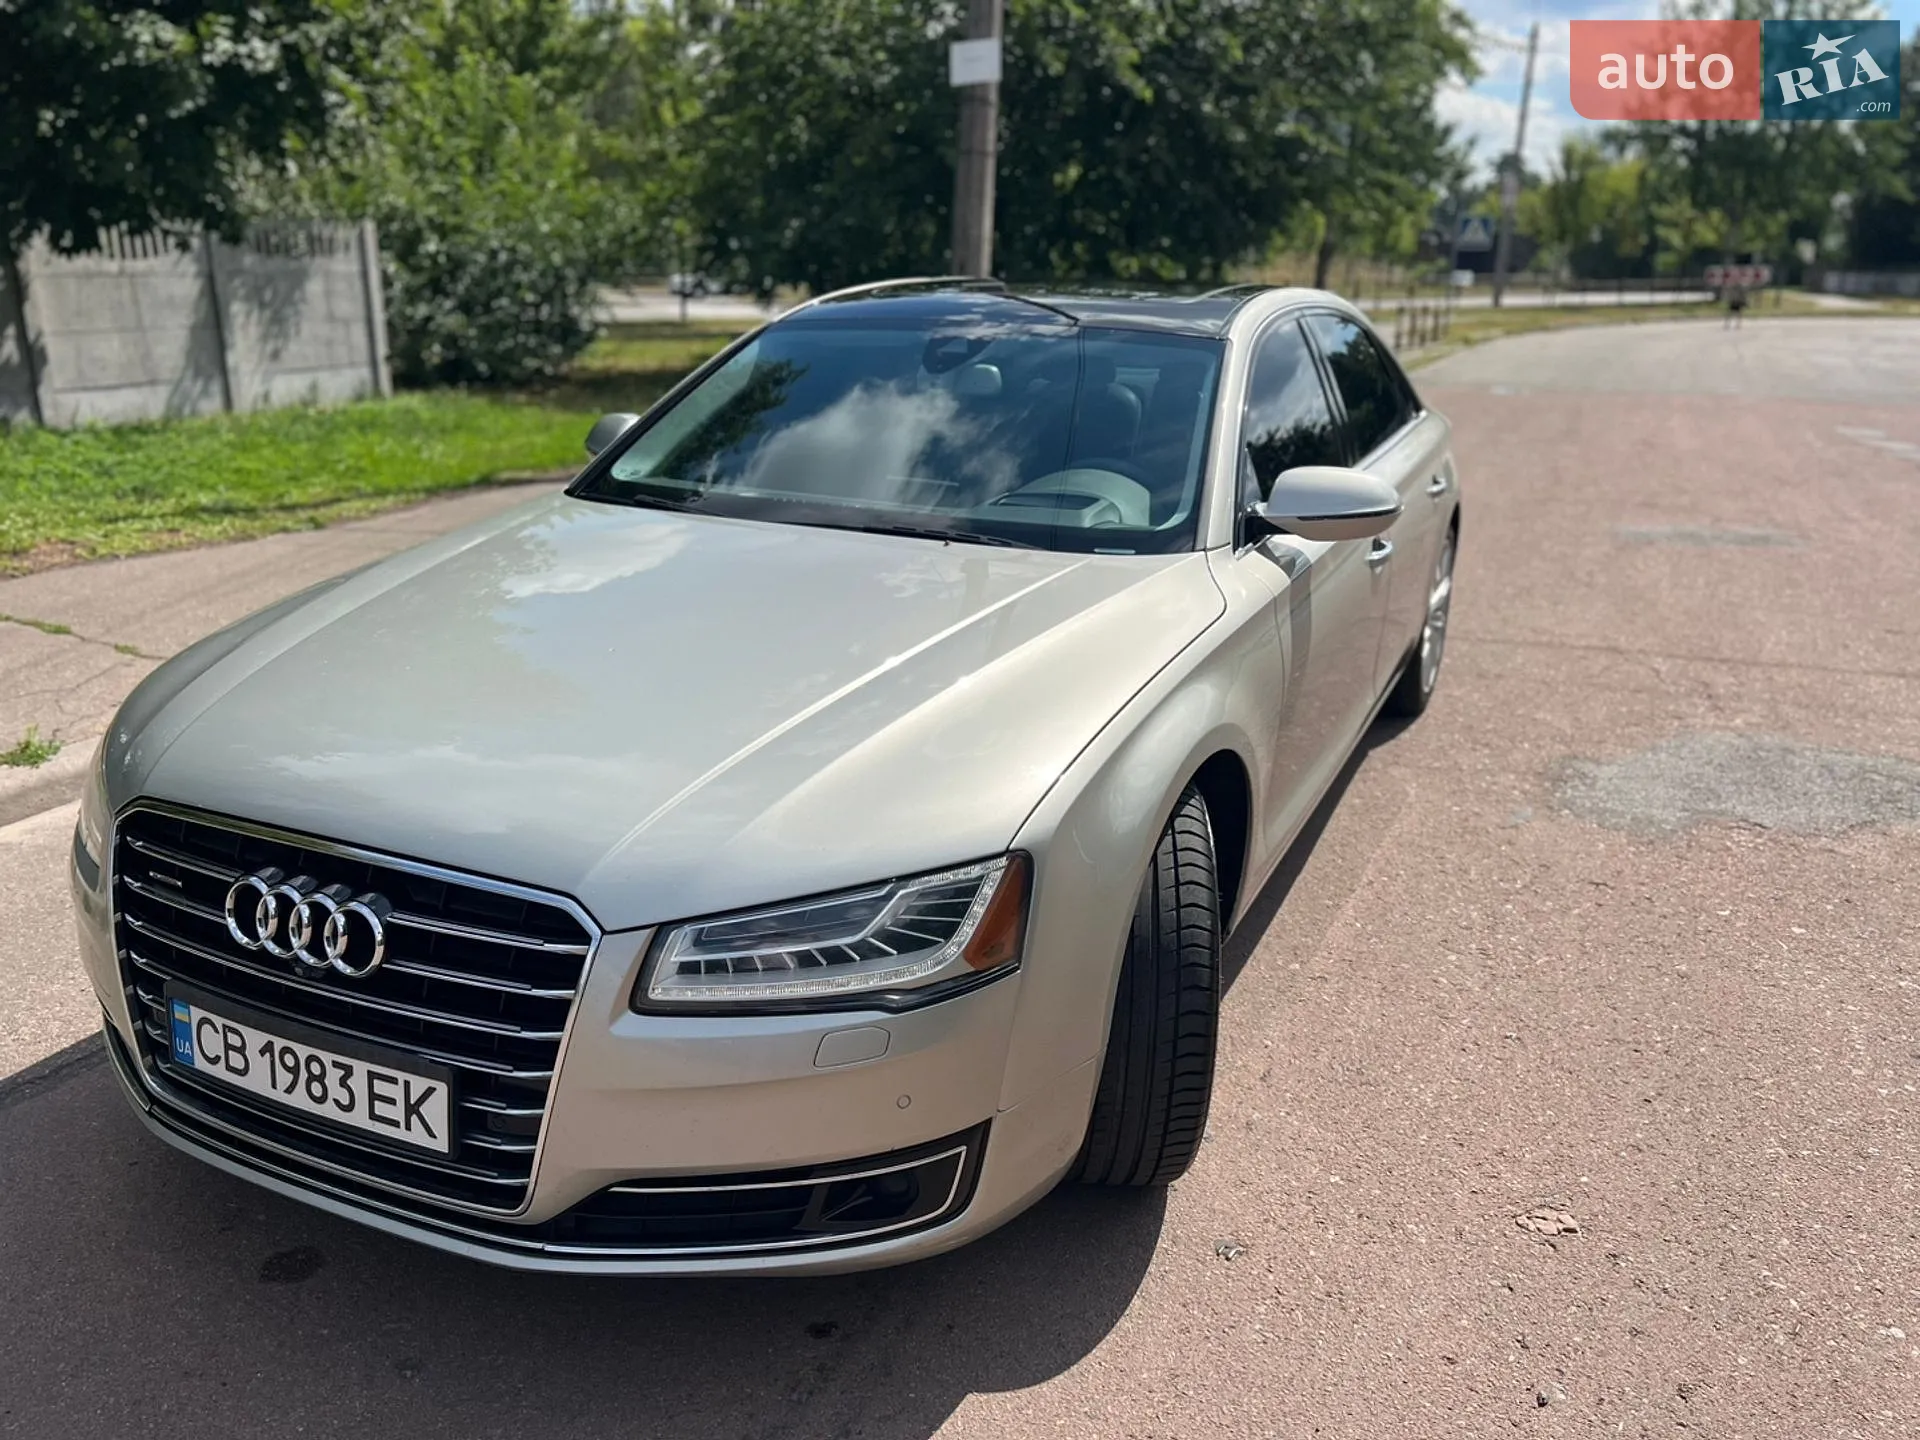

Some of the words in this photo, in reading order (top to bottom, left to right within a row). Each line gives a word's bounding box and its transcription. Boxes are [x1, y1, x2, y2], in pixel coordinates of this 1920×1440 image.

[176, 1037, 192, 1057] UA
[196, 1016, 250, 1077] CB
[258, 1039, 356, 1113] 1983
[366, 1070, 438, 1139] EK
